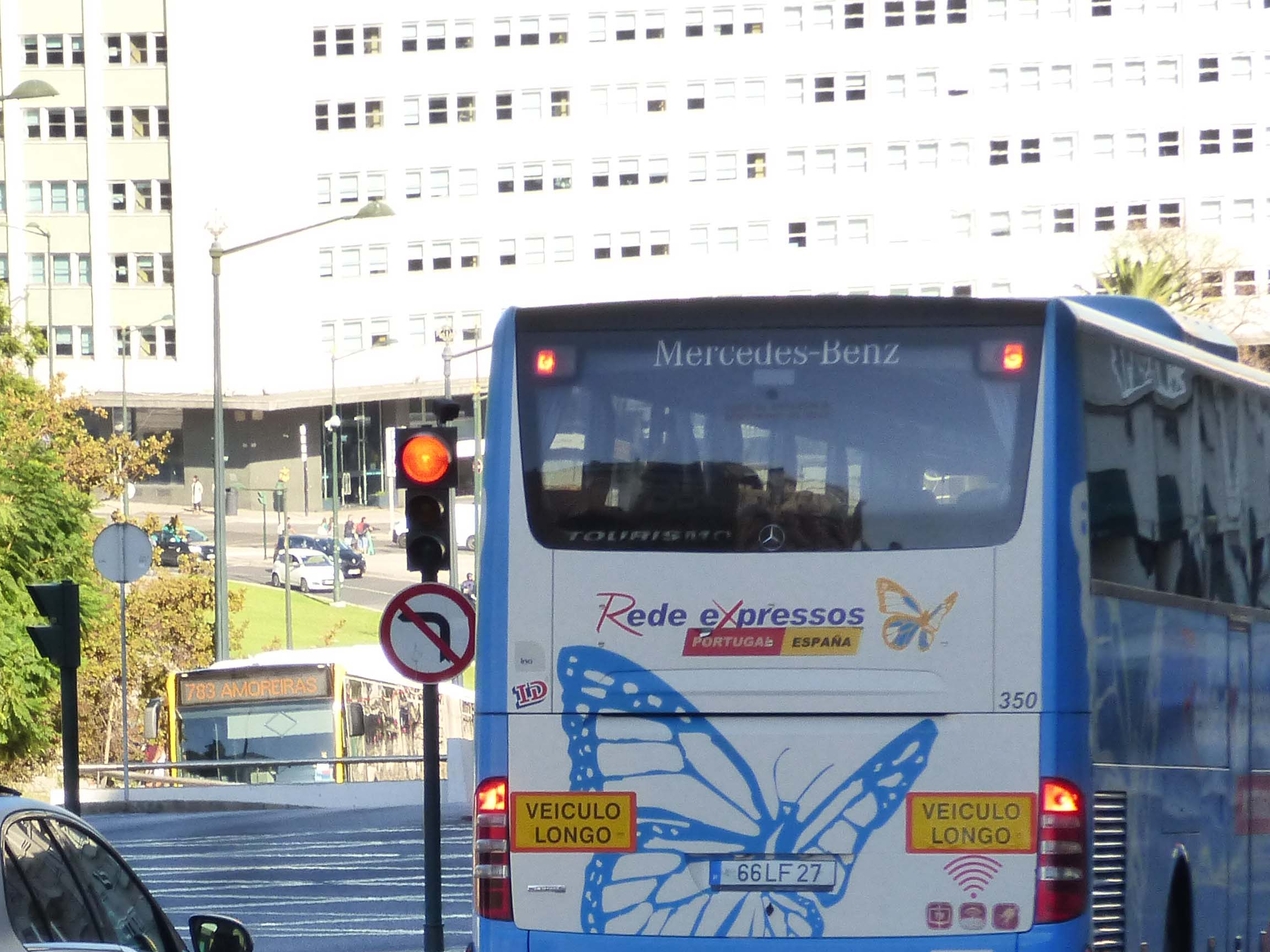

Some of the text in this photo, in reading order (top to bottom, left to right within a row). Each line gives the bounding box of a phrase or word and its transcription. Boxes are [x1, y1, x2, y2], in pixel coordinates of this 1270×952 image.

[653, 339, 901, 367] Mercedes-Benz
[596, 592, 688, 636] Rede
[691, 634, 852, 649] PORTUGAL ESPAÑA
[184, 676, 318, 701] 783 AMOREIRAS
[999, 691, 1038, 709] 350
[525, 802, 621, 820] VEICULO
[922, 802, 1020, 820] VEICULO
[535, 826, 611, 844] LONGO
[931, 826, 1011, 844] LONGO
